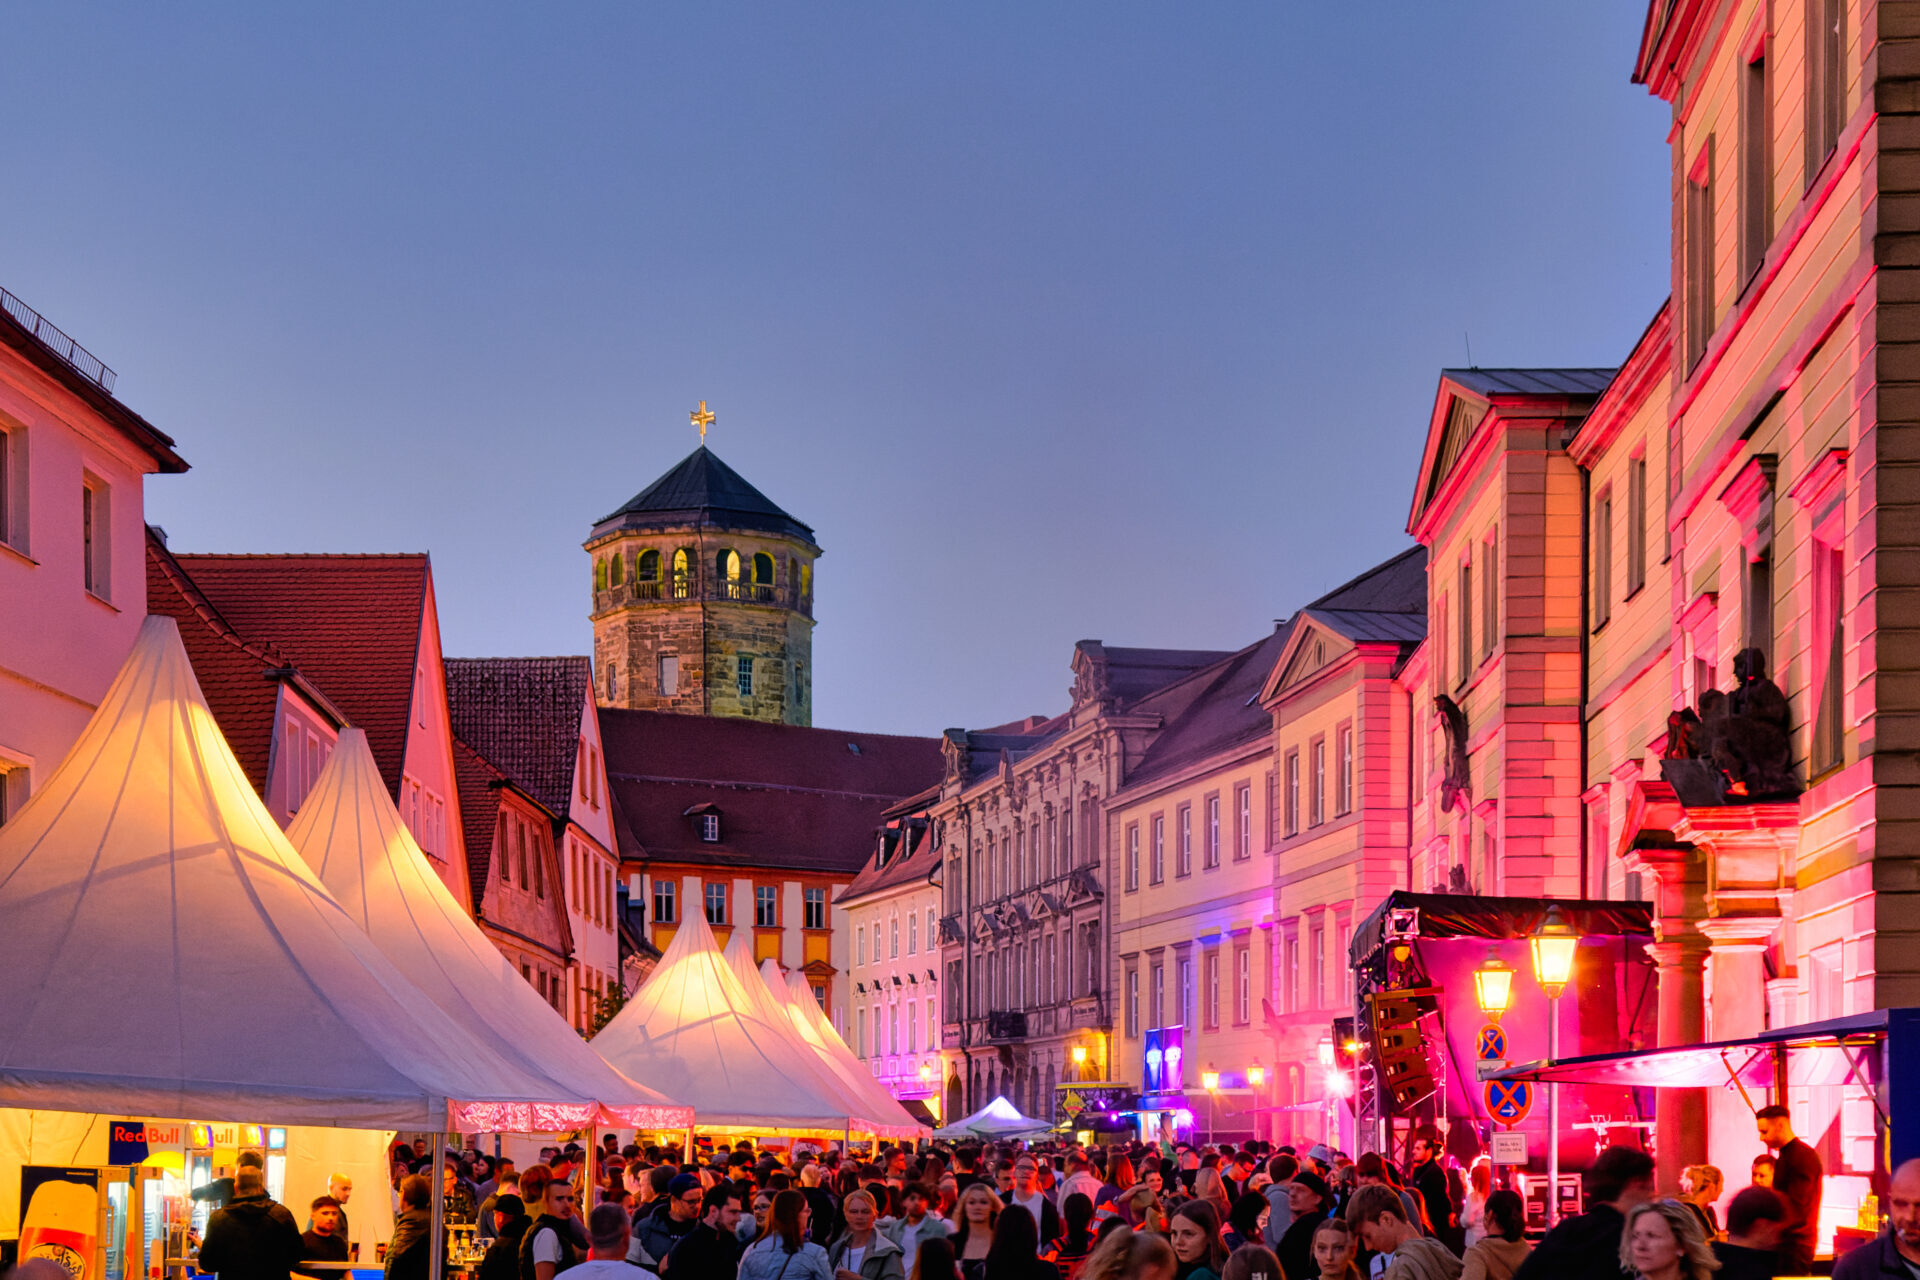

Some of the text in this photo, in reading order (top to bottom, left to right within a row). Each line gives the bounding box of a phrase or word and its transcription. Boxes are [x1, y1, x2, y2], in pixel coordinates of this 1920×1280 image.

[114, 1126, 179, 1144] Red Bull
[212, 1128, 233, 1144] ull
